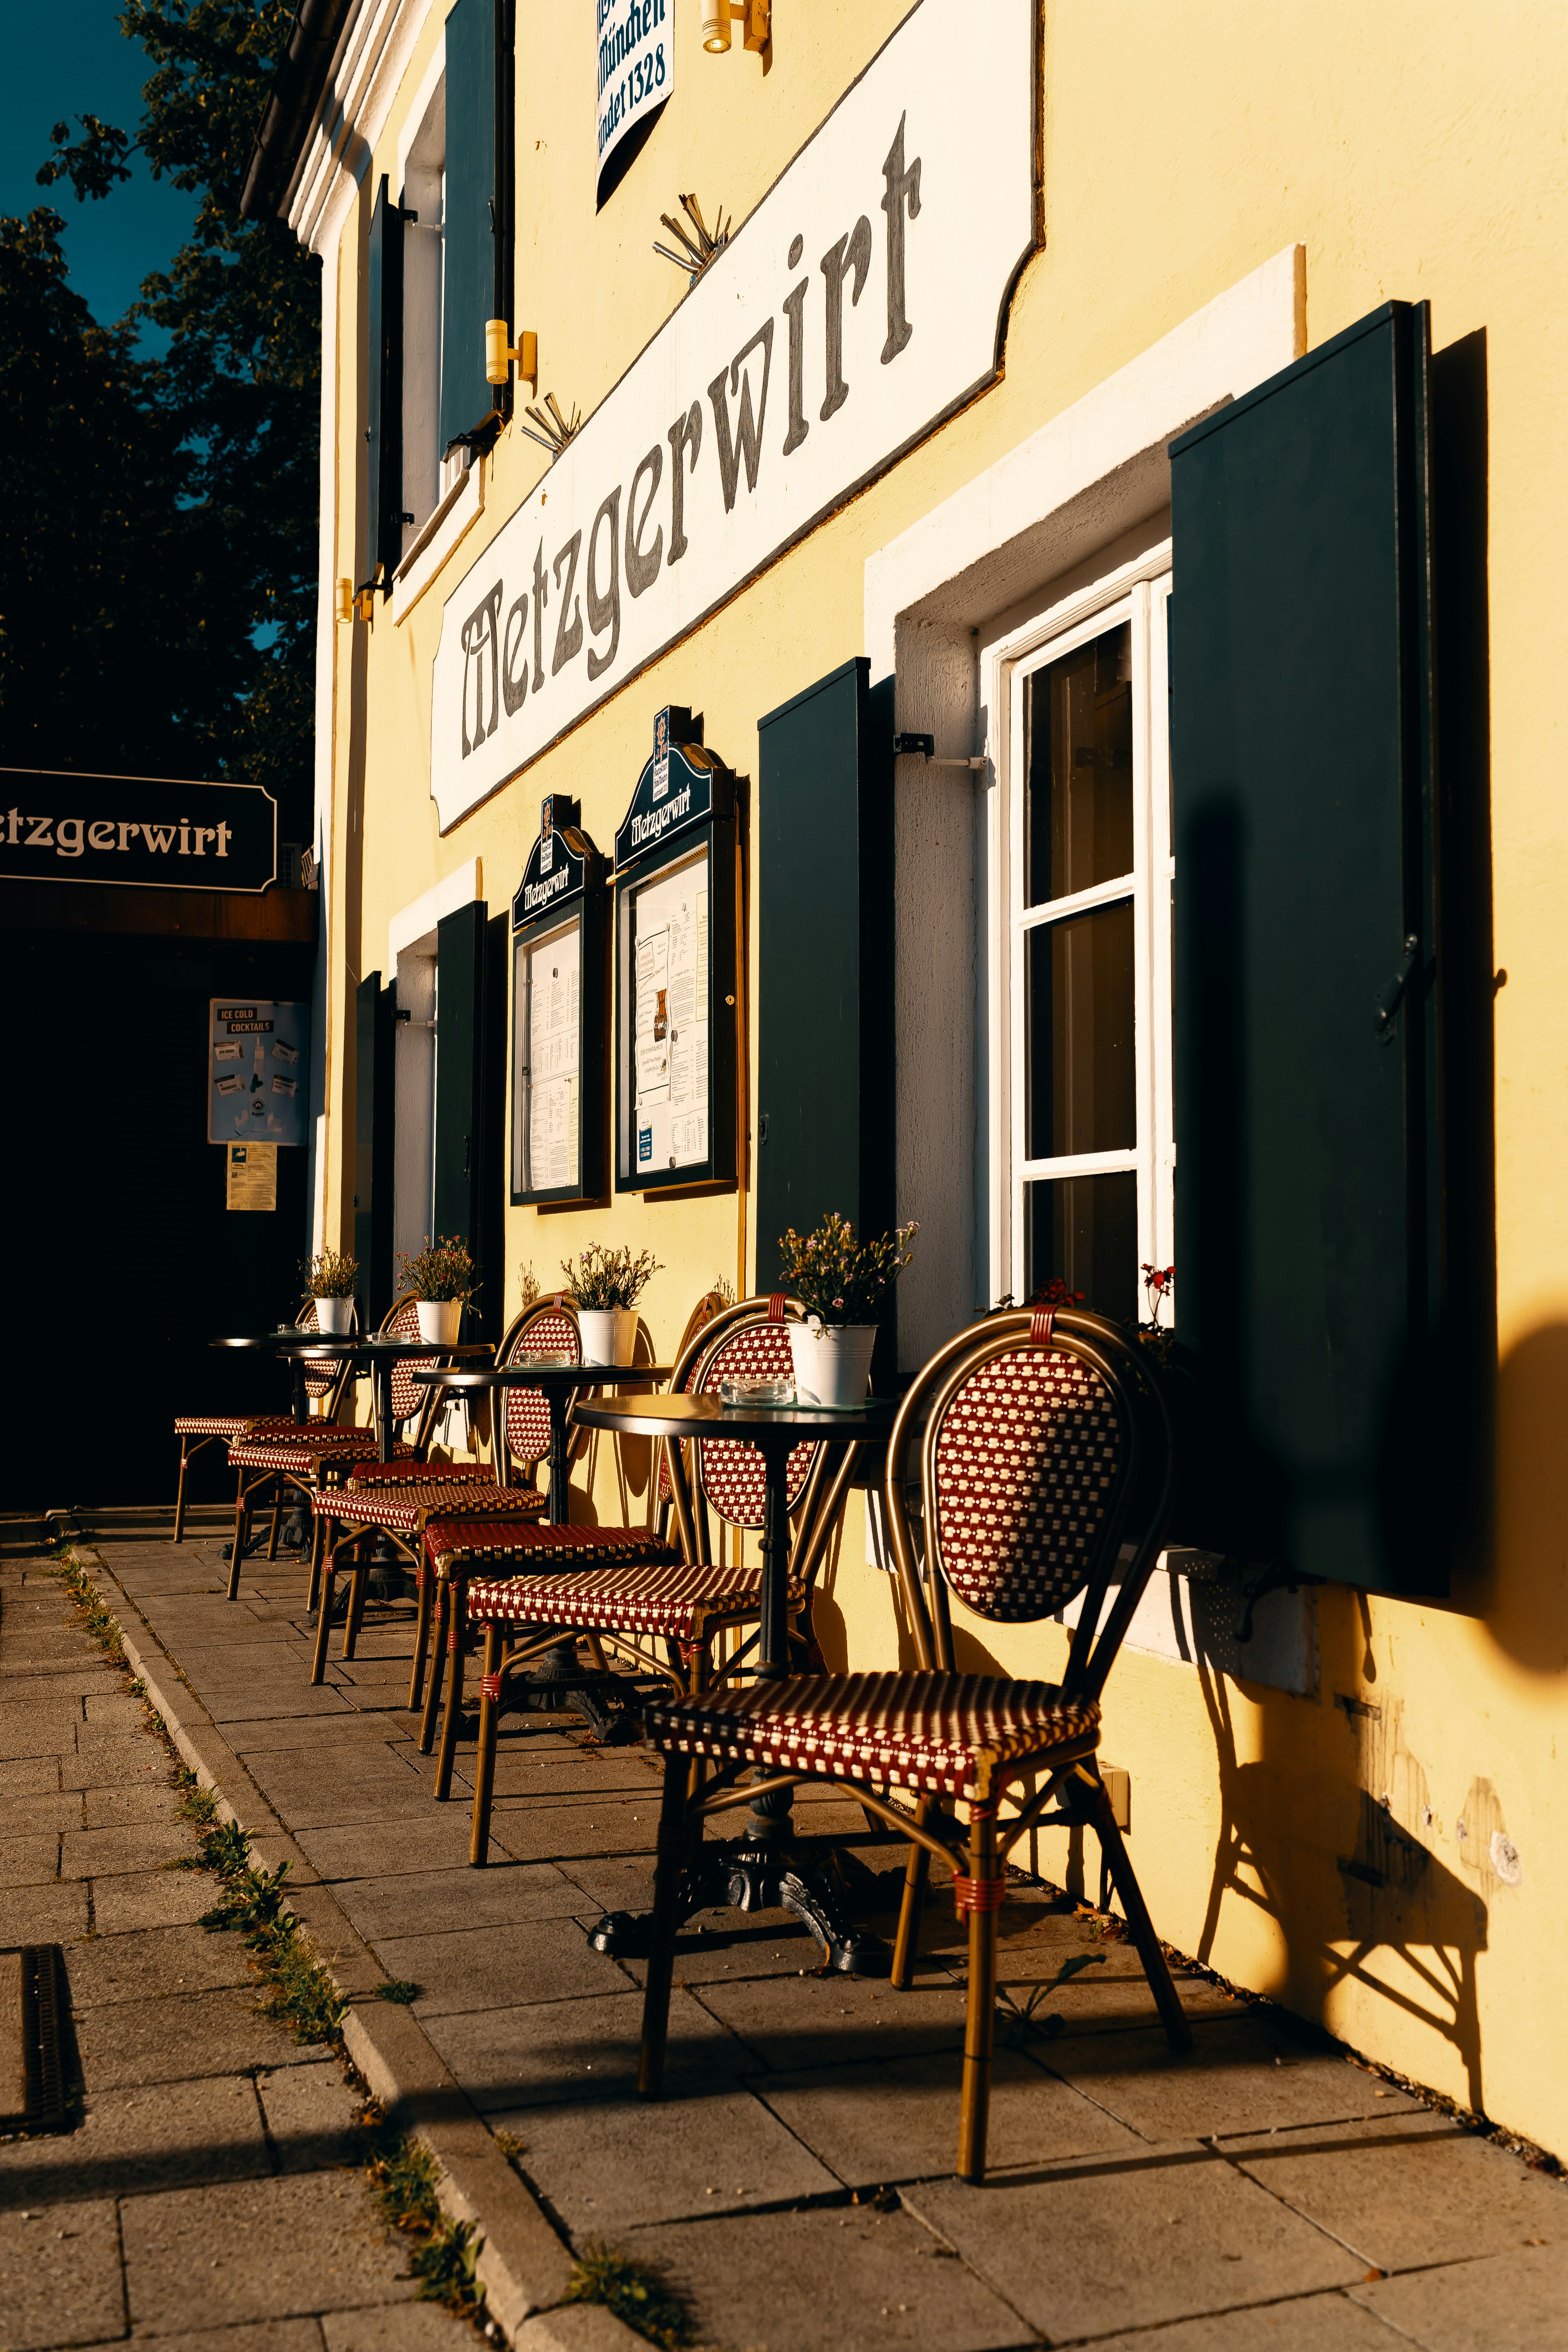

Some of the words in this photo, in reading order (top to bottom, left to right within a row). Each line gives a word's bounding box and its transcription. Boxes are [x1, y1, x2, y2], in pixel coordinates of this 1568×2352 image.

[628, 43, 665, 109] 1328
[461, 109, 922, 760] Metzgerwirt
[631, 782, 690, 847] Metzgerwirt
[525, 862, 569, 910] Metzgerwirt
[222, 1011, 232, 1019] ICE
[235, 1010, 253, 1019] COLD
[231, 1022, 269, 1032] COCKTAILS
